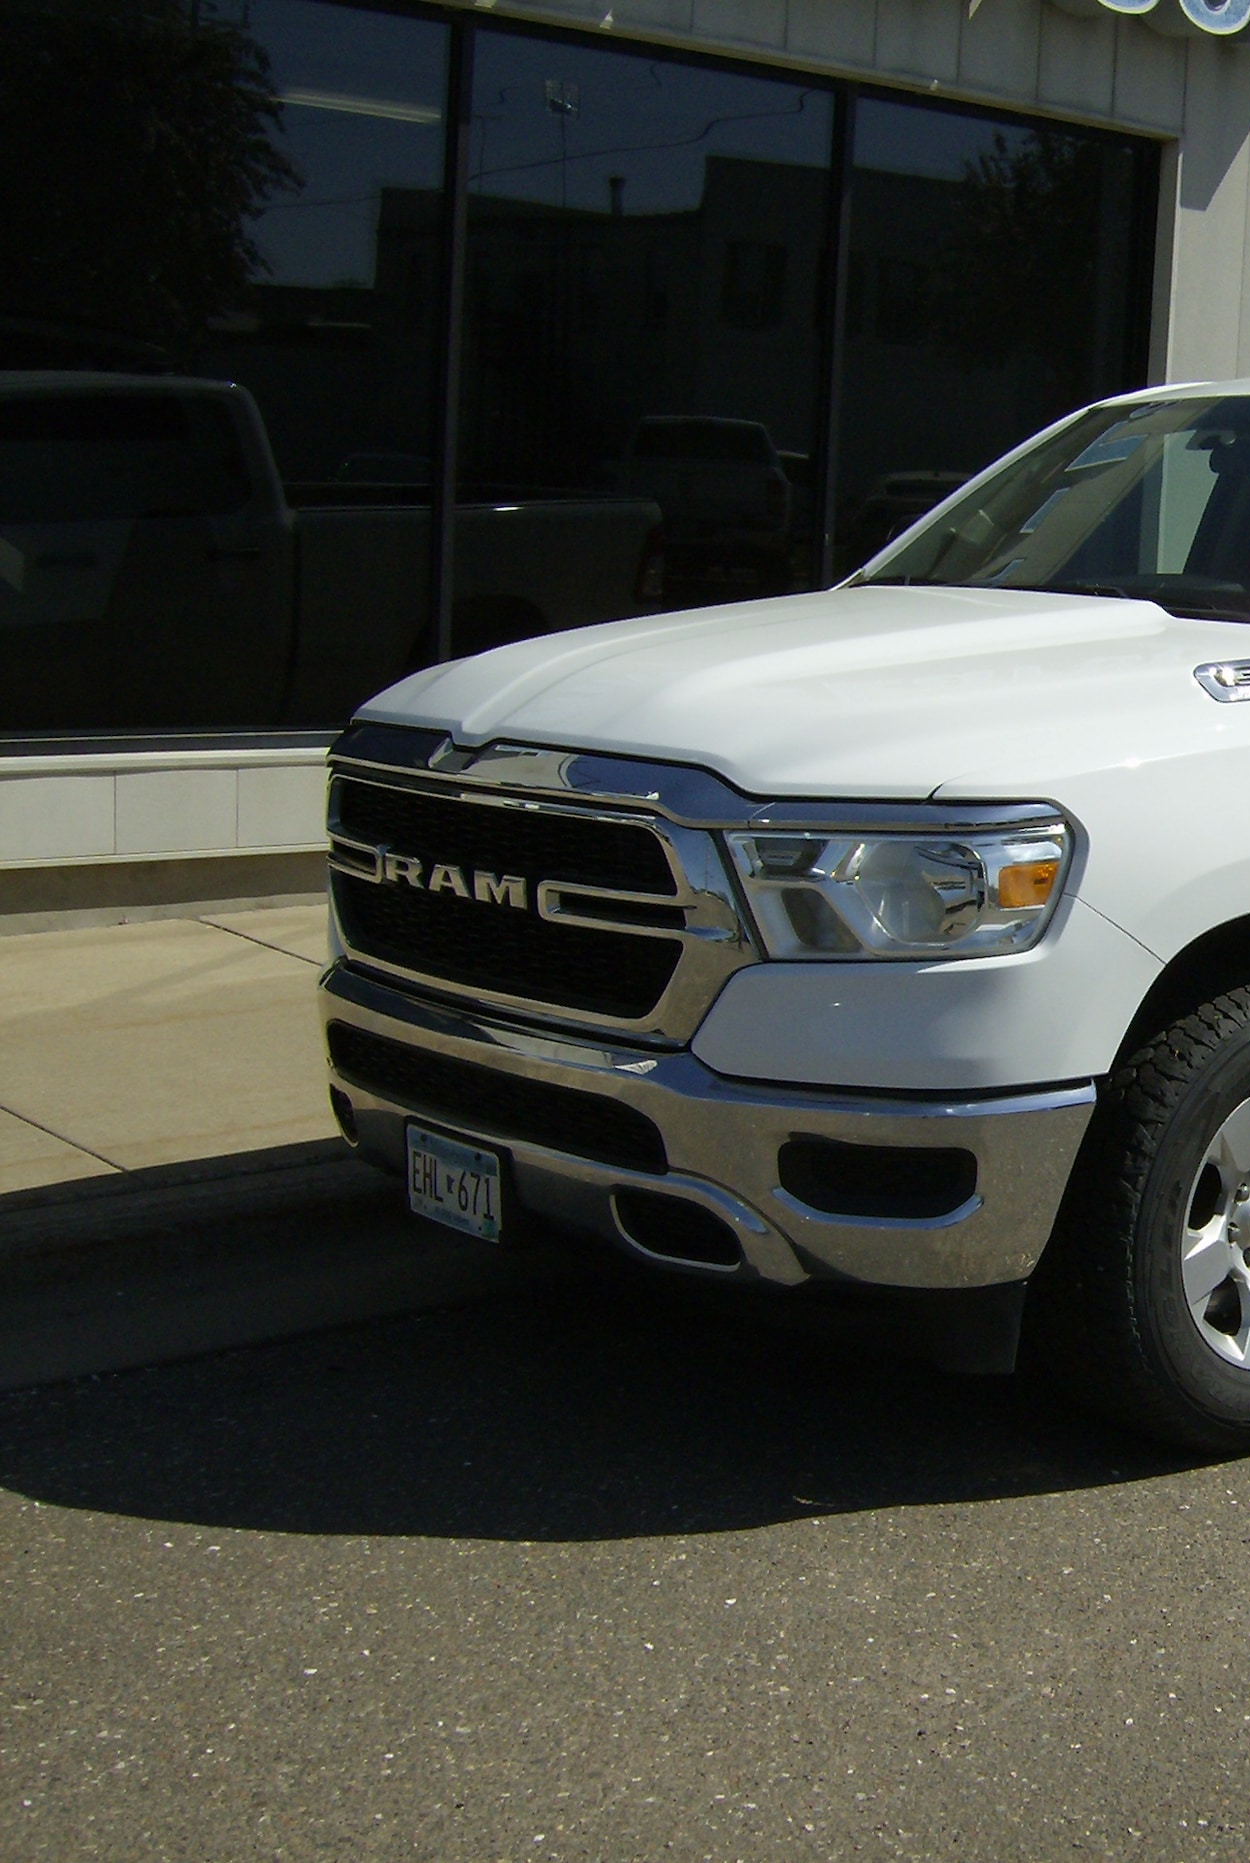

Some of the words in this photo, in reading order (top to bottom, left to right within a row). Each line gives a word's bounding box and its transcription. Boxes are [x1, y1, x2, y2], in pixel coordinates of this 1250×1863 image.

[384, 853, 528, 909] RAM
[412, 1150, 443, 1203] EHL
[457, 1170, 495, 1221] 671
